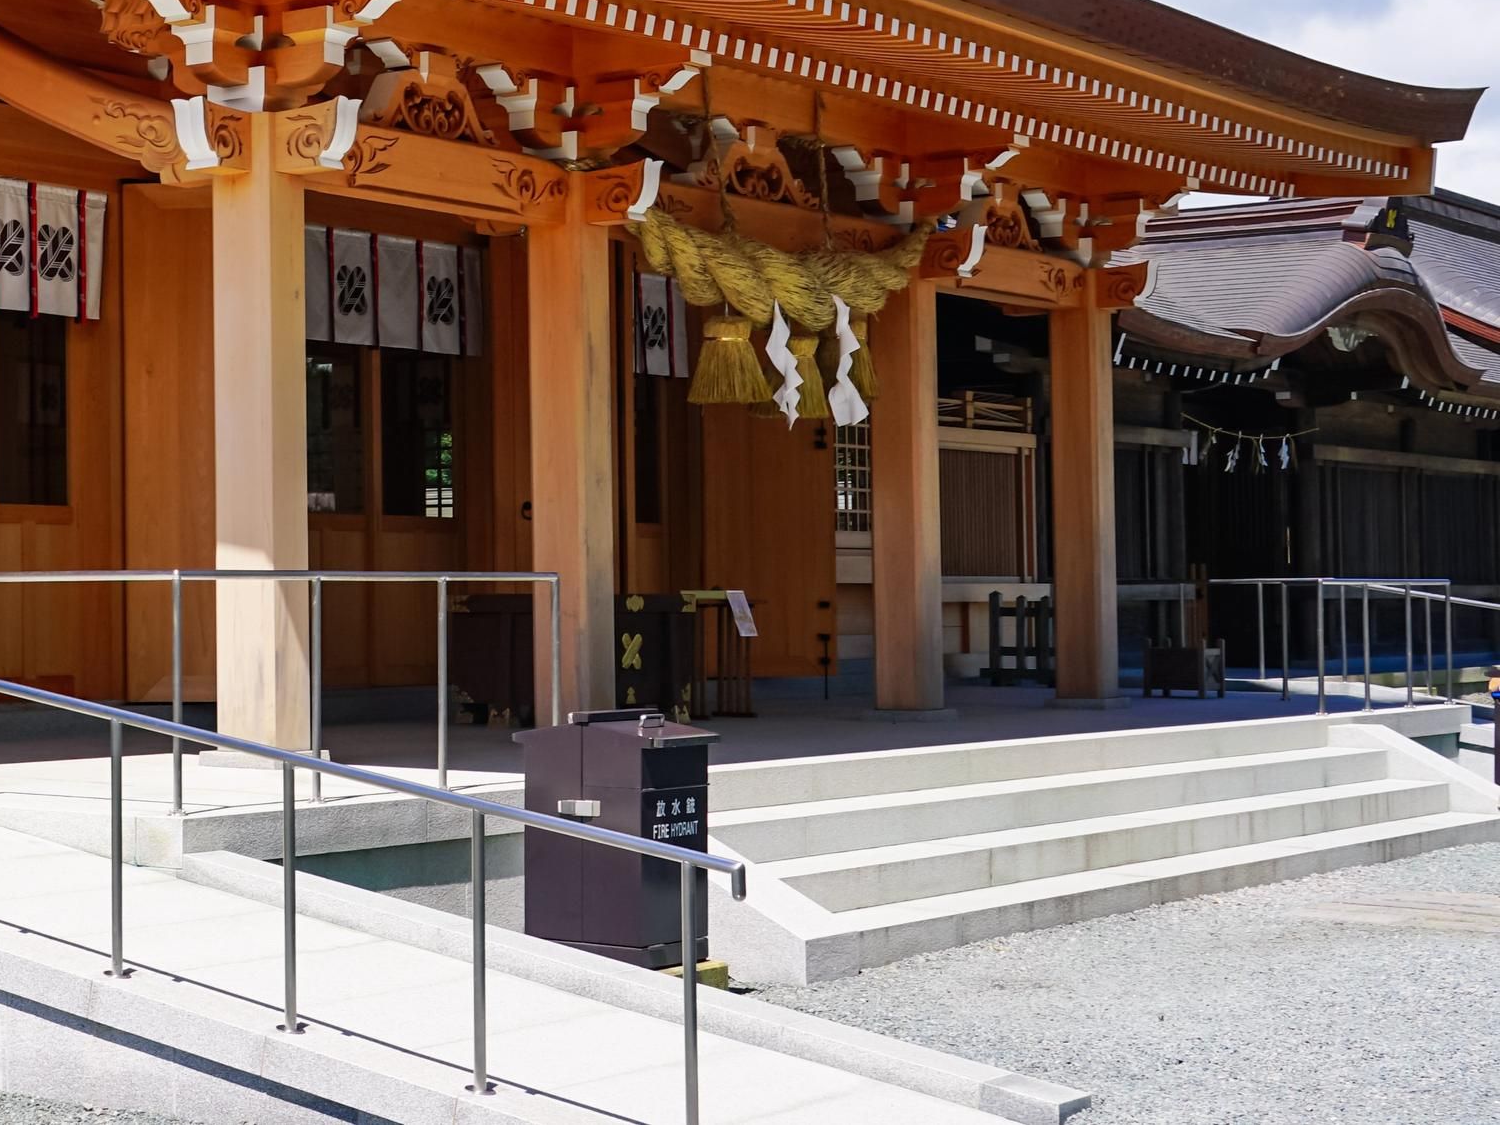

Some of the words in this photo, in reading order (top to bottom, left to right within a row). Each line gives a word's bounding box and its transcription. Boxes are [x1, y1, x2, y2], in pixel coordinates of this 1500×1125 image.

[656, 797, 695, 817] 放水銃
[653, 823, 669, 839] FIRE
[670, 820, 698, 837] HYDRANT
